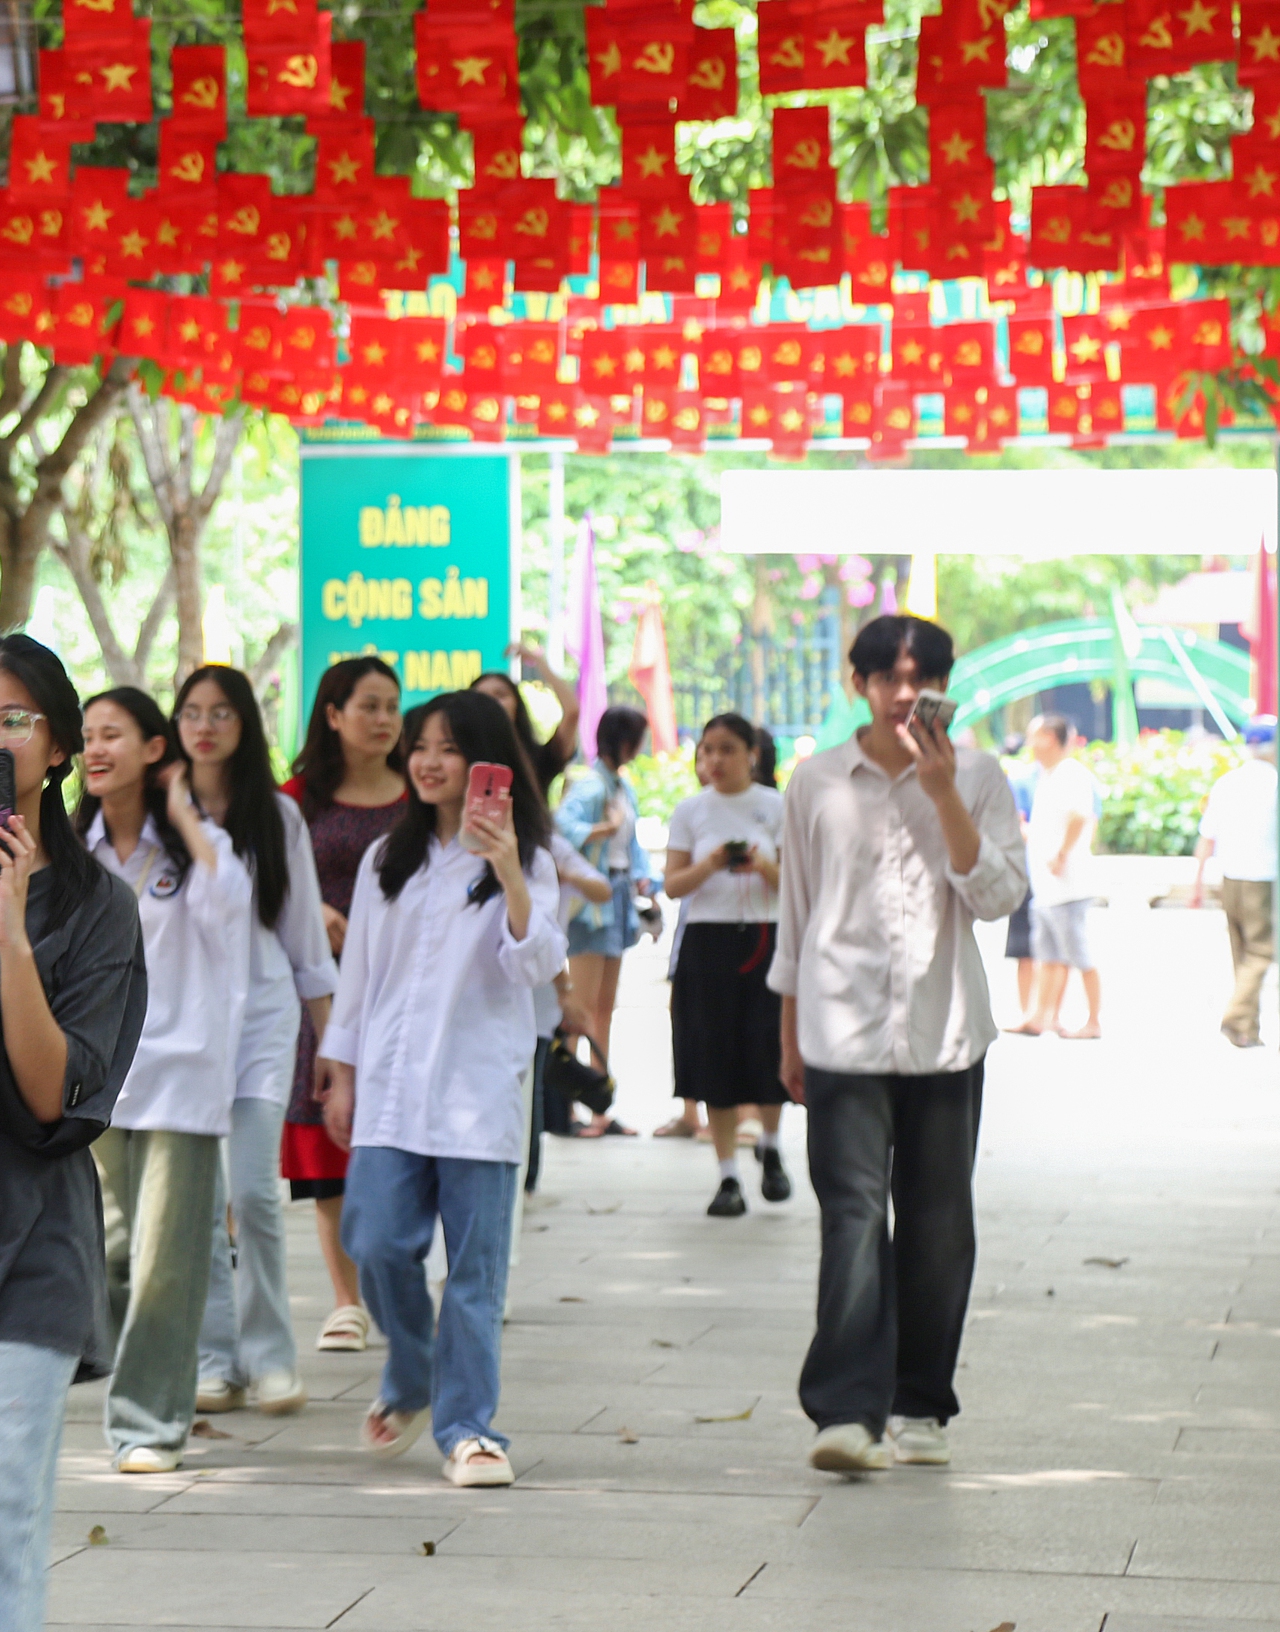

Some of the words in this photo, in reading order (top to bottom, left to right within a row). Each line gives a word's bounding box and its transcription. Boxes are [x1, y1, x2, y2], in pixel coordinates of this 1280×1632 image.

[358, 493, 451, 547] ĐẢNG
[322, 570, 413, 628] CỘNG
[417, 564, 489, 620] SẢN
[403, 649, 482, 692] NAM
